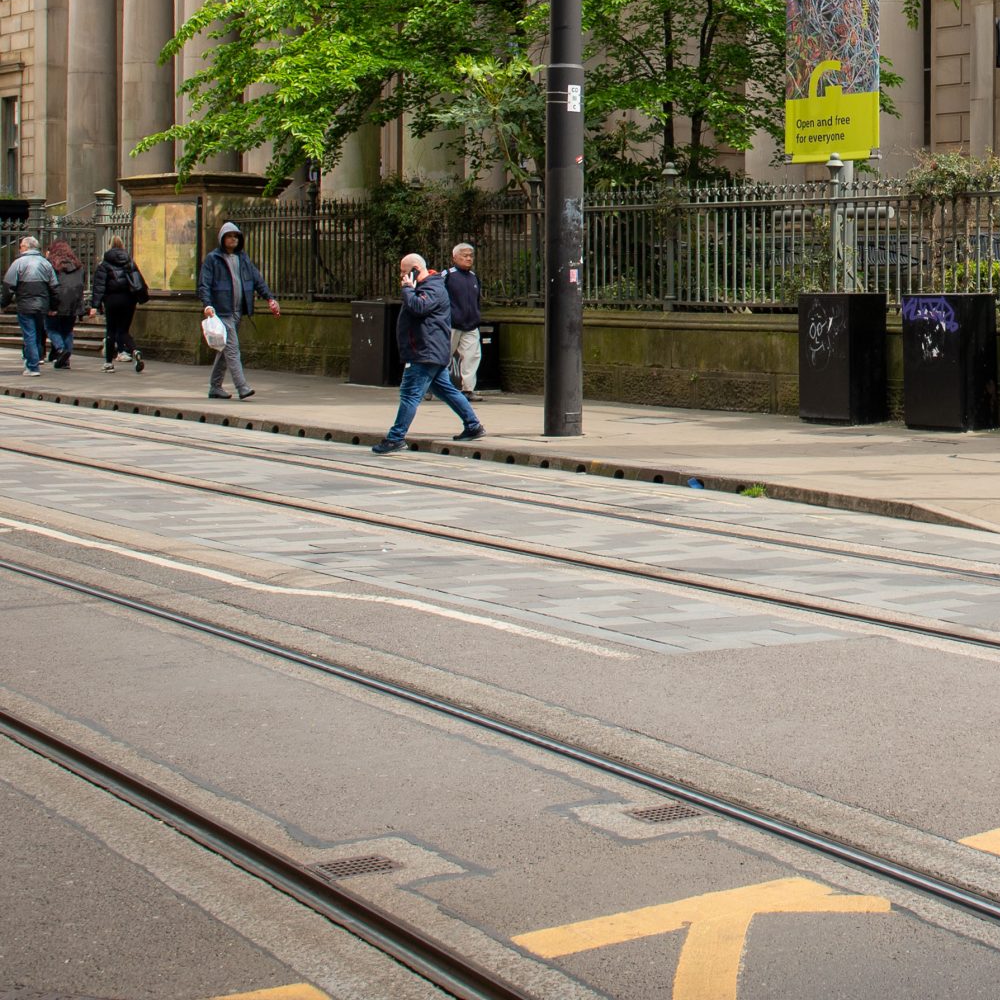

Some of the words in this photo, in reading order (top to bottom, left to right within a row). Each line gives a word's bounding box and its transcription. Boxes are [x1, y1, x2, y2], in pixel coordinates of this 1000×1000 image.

[796, 119, 815, 130] Open
[816, 115, 833, 127] and
[835, 115, 851, 126] free
[796, 133, 806, 144] for
[808, 132, 845, 145] everyone
